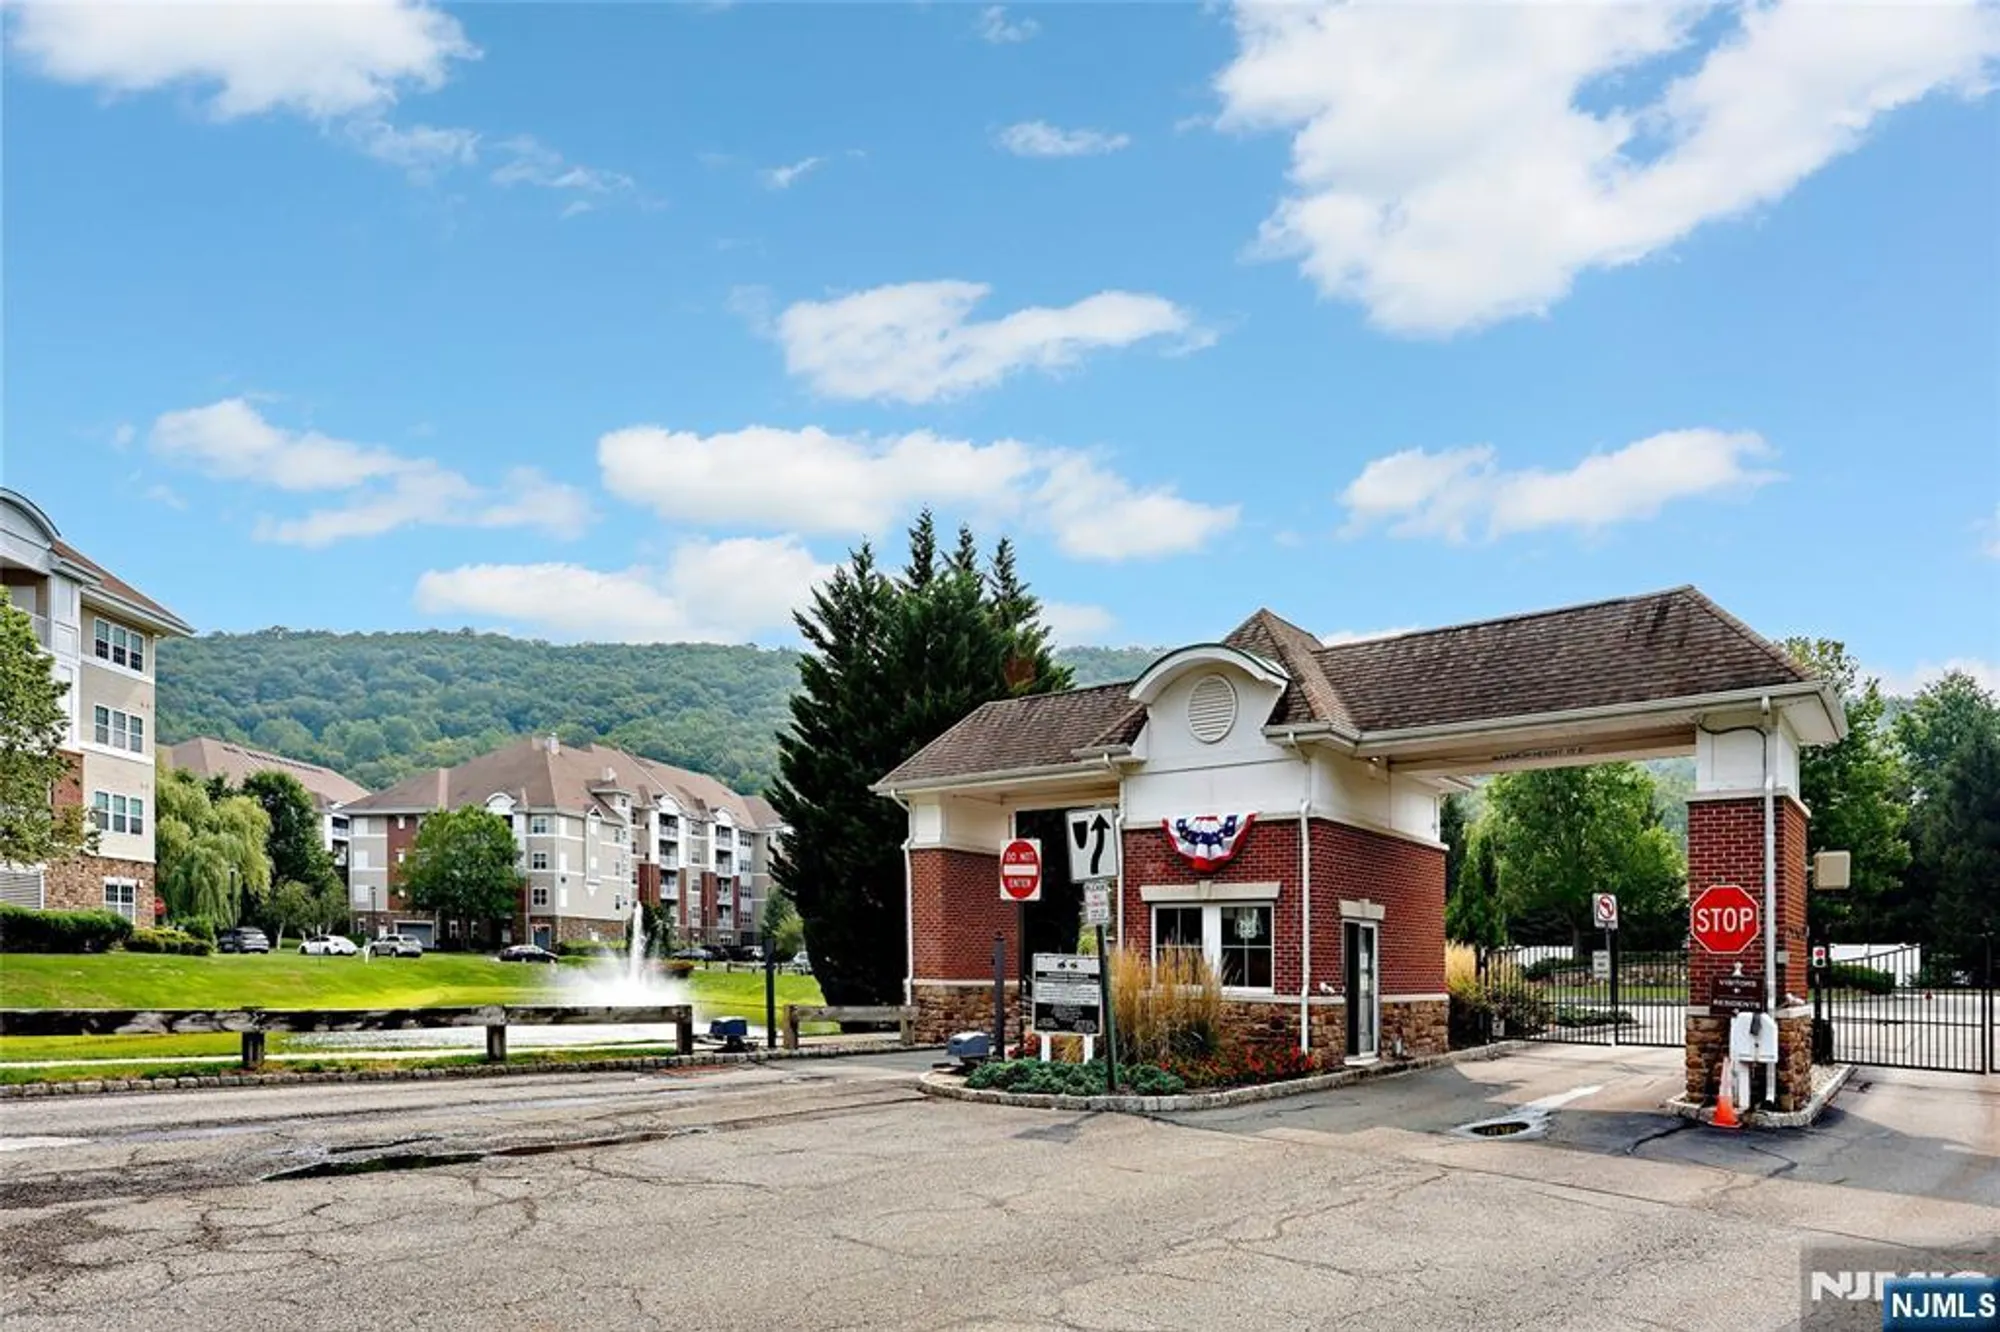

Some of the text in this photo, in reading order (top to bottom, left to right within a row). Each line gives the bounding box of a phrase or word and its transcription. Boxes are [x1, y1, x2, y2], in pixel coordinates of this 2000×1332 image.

[1006, 851, 1035, 862] DO NOT
[1696, 907, 1754, 933] STOP
[1718, 979, 1758, 988] VISITORS
[1712, 999, 1761, 1009] RESIDENTS
